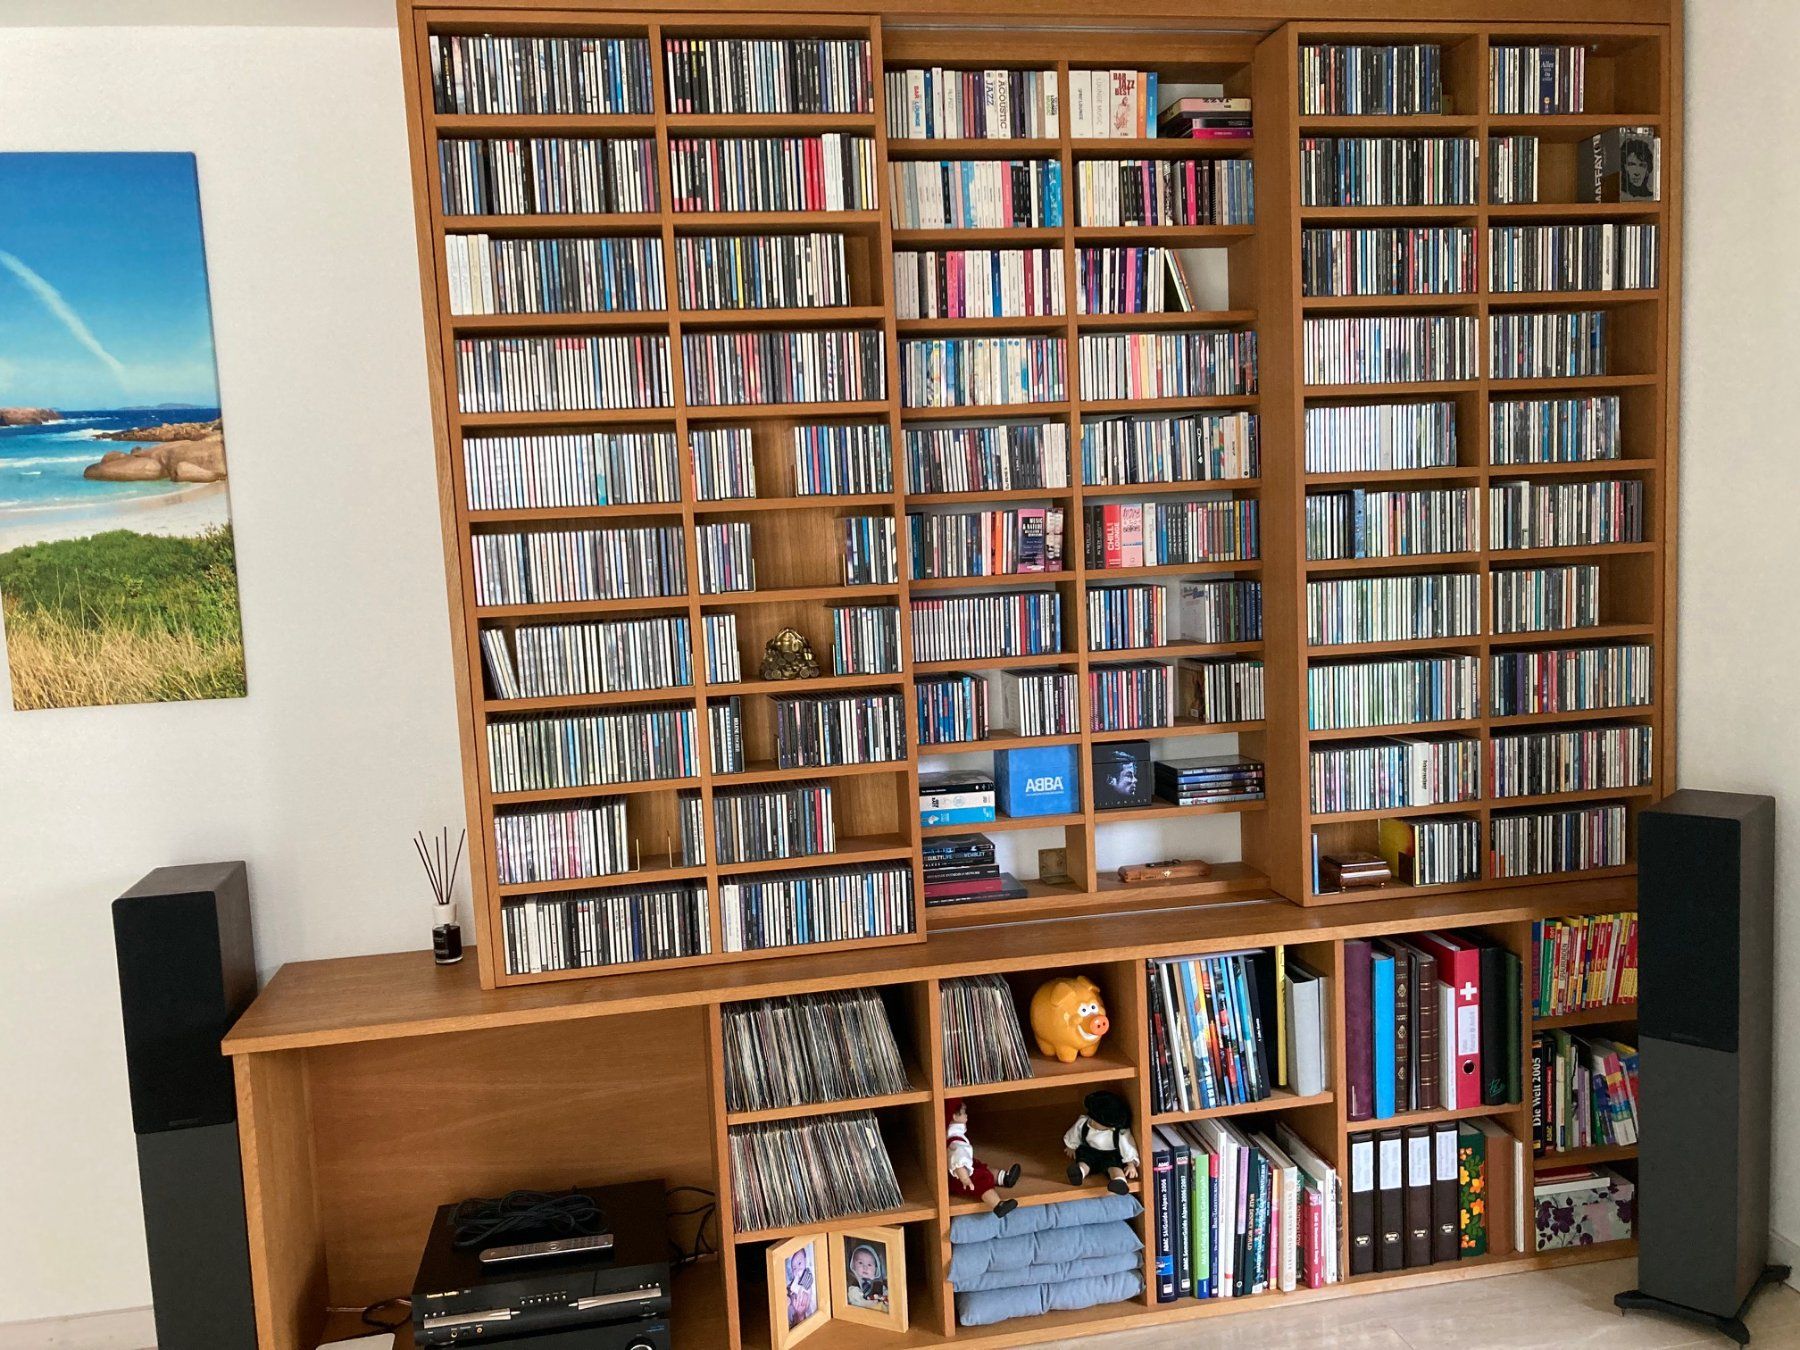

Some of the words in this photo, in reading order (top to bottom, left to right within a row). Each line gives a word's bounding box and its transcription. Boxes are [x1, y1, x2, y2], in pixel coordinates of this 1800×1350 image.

[1113, 72, 1126, 80] BAR
[986, 80, 994, 106] JAZZ
[1114, 88, 1130, 96] BEST
[1119, 80, 1135, 90] JAZZ
[998, 80, 1007, 129] ACOUSTIC
[1026, 776, 1063, 792] ABBA
[1532, 1057, 1541, 1084] 2005
[1532, 1084, 1541, 1108] Welt
[1533, 1109, 1541, 1126] Die
